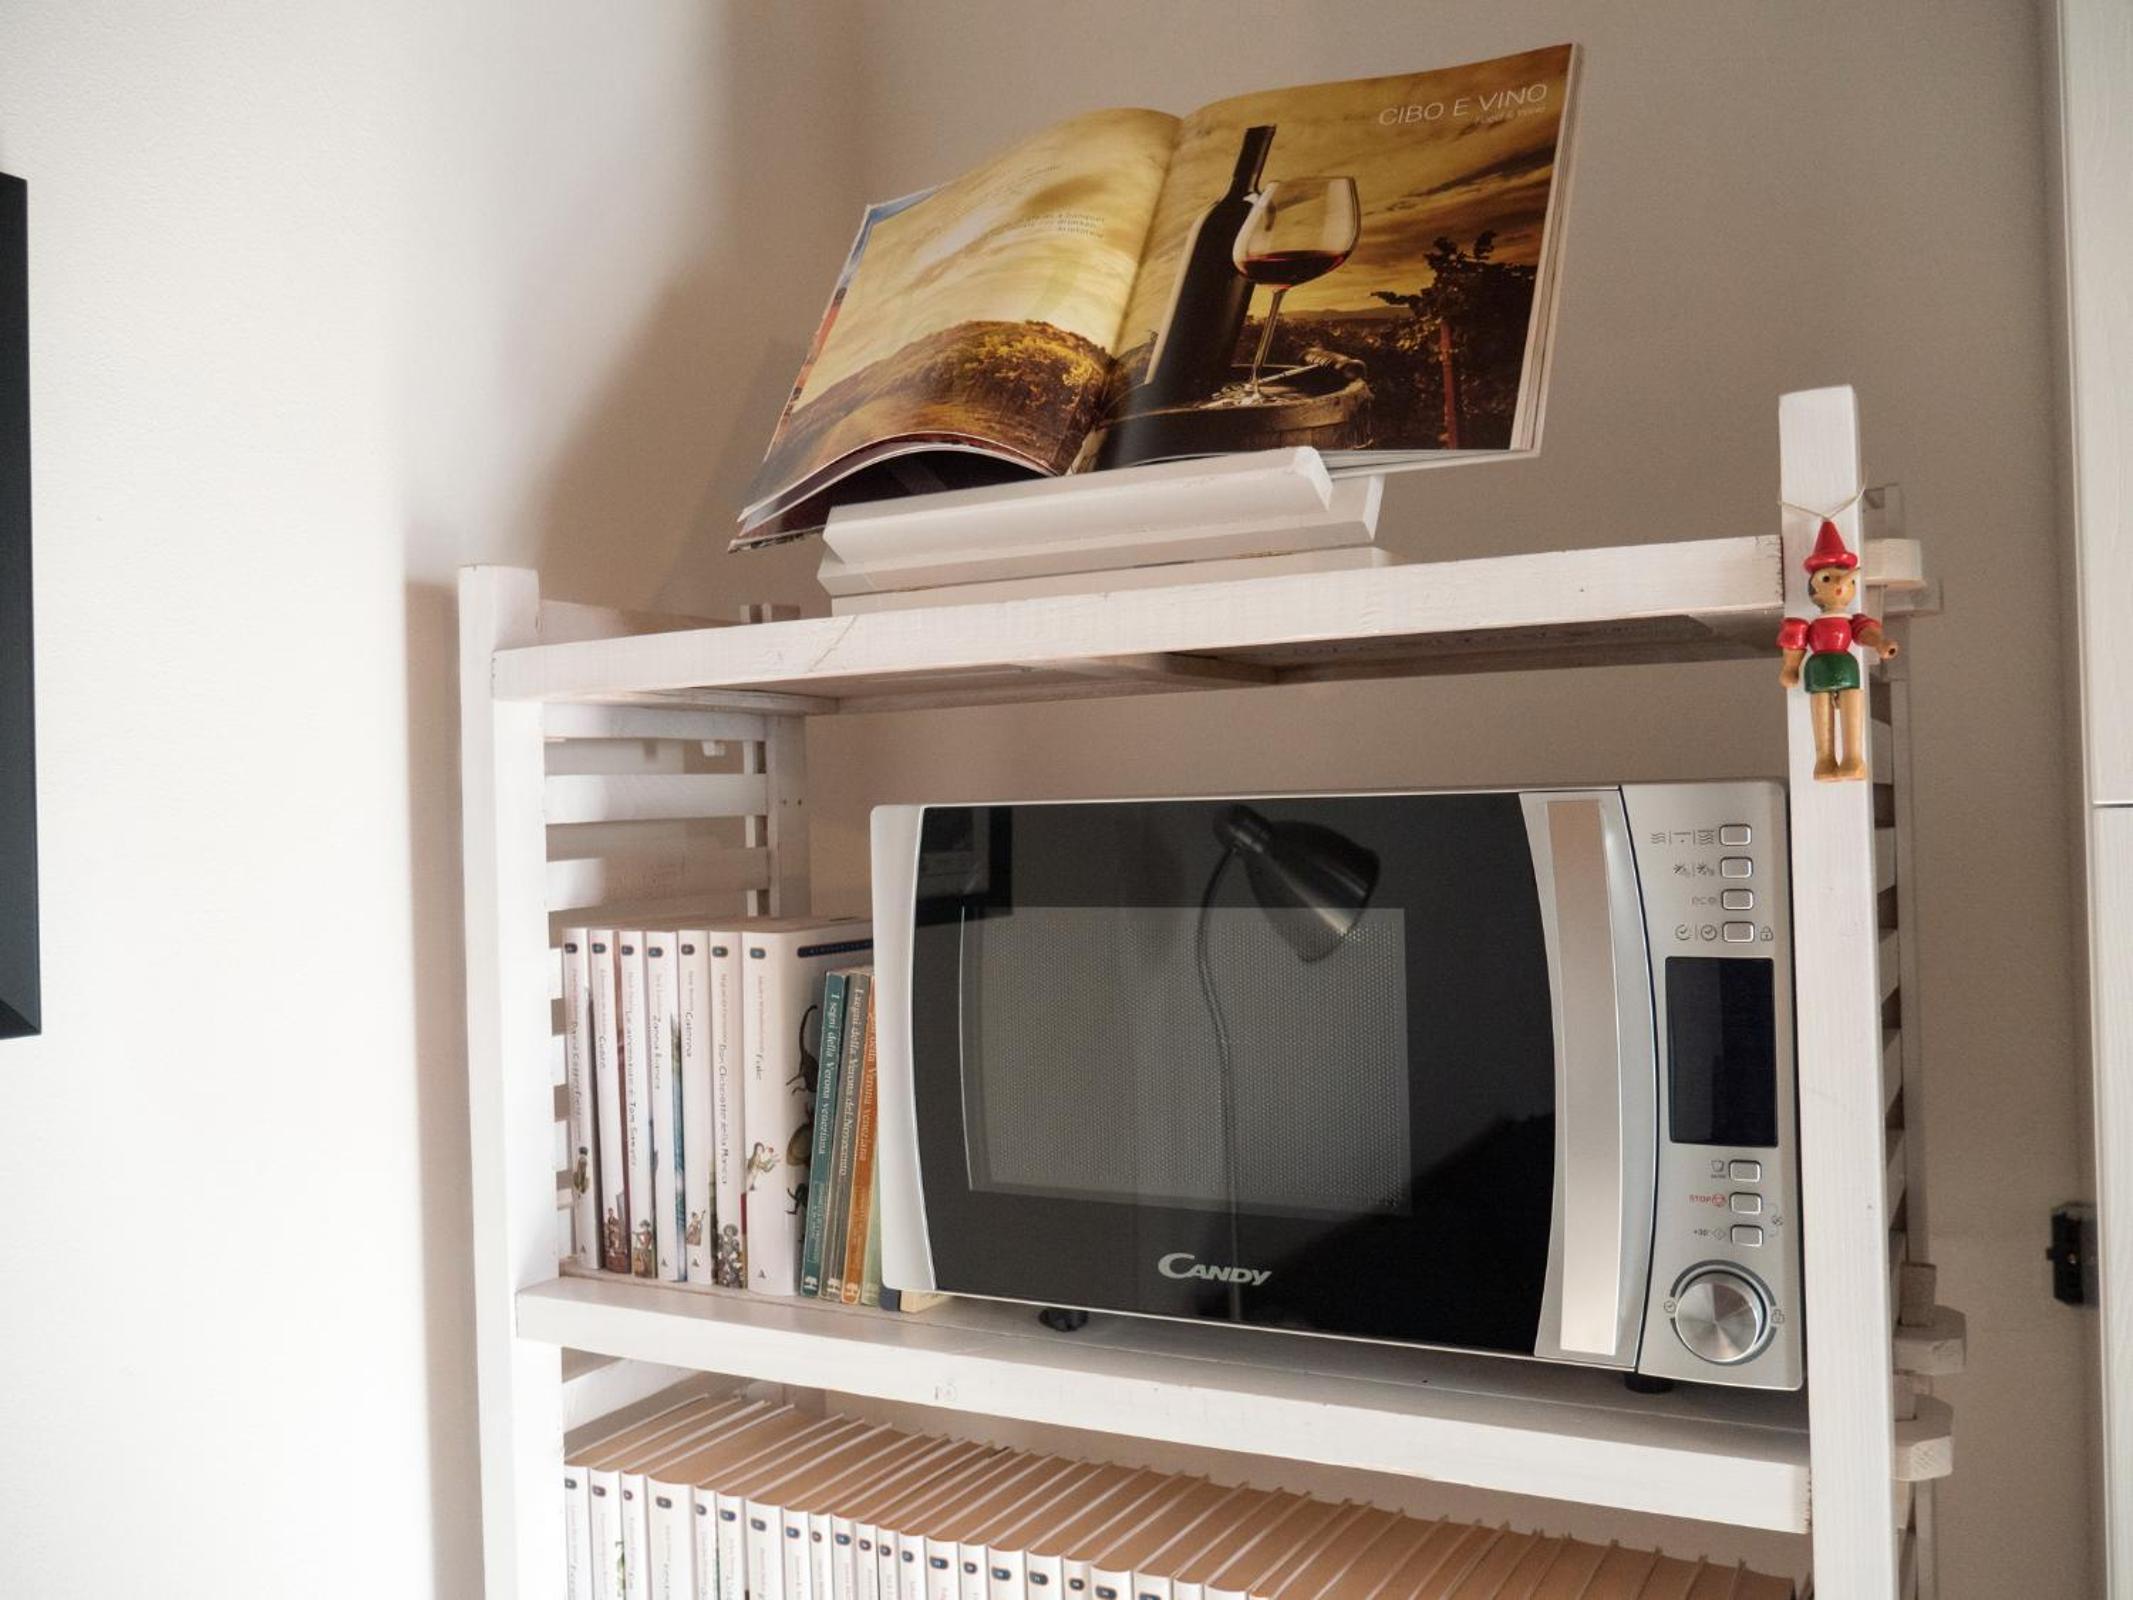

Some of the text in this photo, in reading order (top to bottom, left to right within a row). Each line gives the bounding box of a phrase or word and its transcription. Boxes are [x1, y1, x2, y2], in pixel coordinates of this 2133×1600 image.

[1378, 102, 1444, 126] CIBO
[1453, 98, 1470, 117] E
[1479, 83, 1548, 112] VINO
[827, 1002, 839, 1029] segni
[826, 1032, 838, 1058] della
[848, 1027, 861, 1055] della
[823, 1061, 836, 1099] Verona
[846, 1059, 859, 1096] Verona
[864, 1068, 877, 1104] Verona
[818, 1104, 831, 1155] veneziana
[839, 1119, 853, 1176] Novecento
[858, 1109, 872, 1161] veneziana
[1689, 1194, 1711, 1203] STOP
